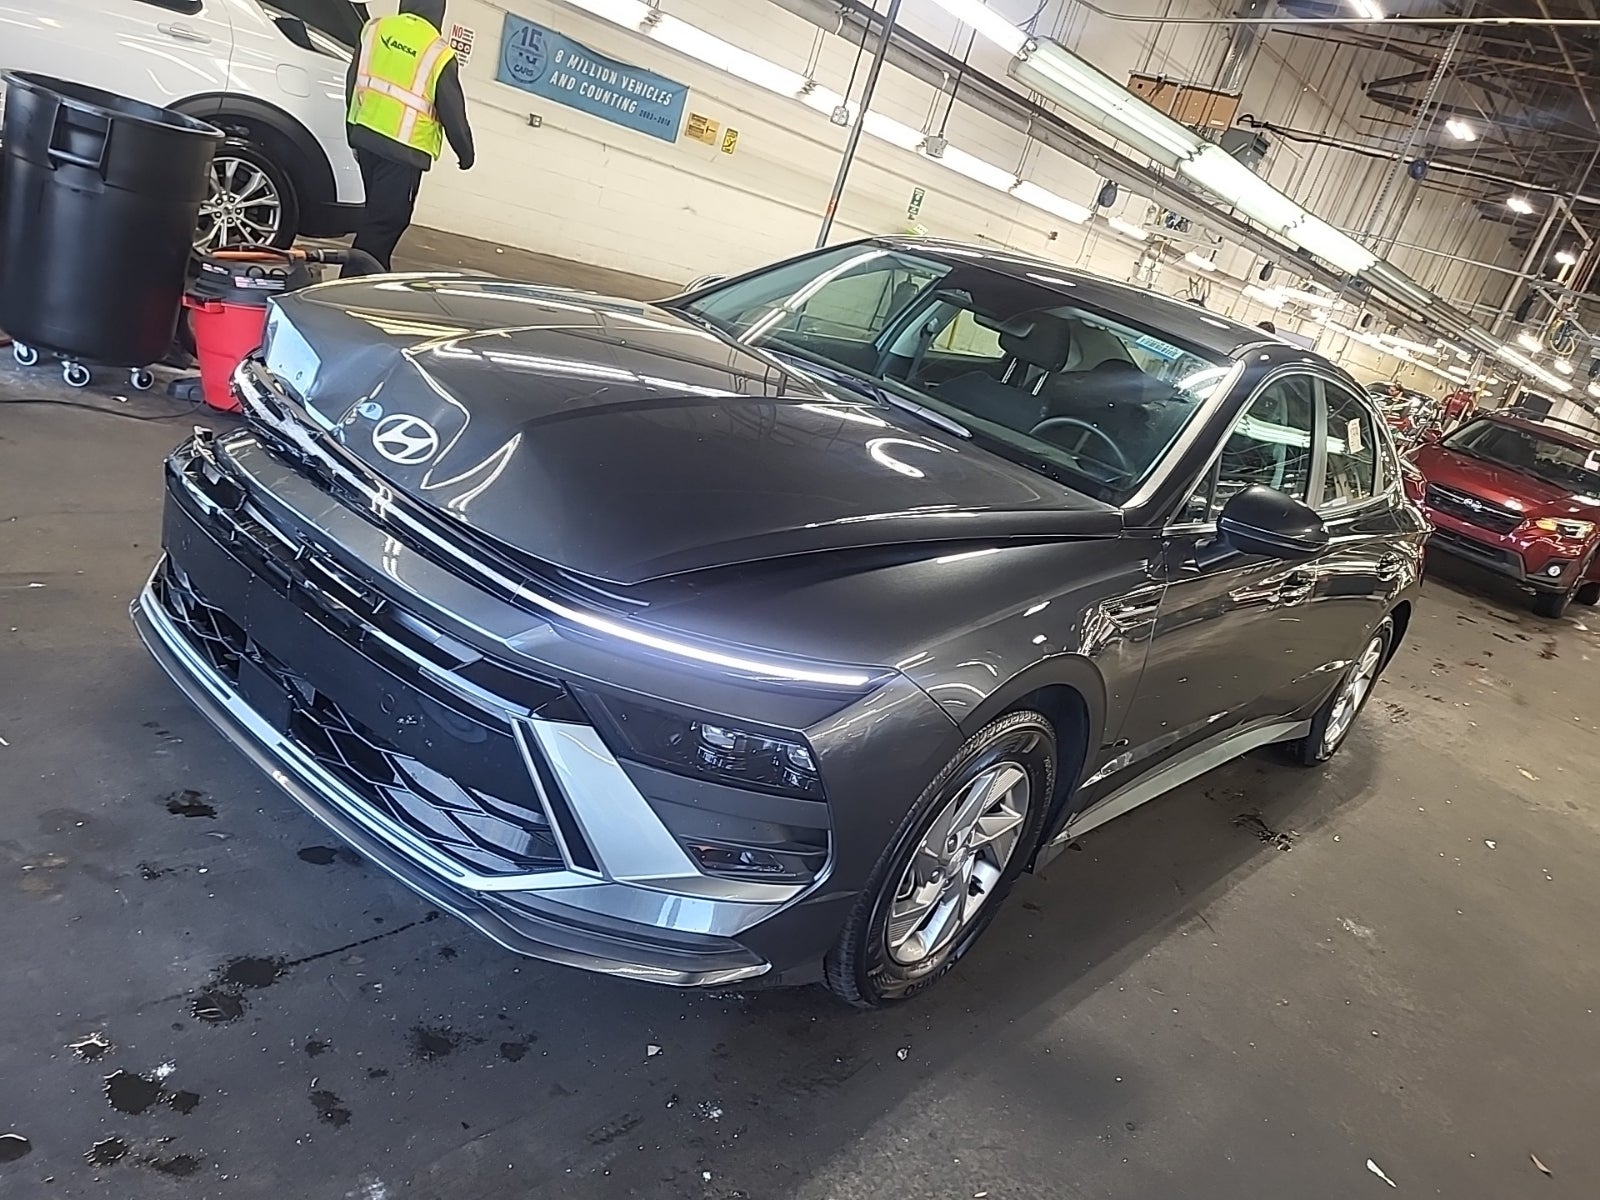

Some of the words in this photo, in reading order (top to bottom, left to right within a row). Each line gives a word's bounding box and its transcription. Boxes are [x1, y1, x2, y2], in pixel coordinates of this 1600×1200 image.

[452, 24, 463, 39] NO
[521, 26, 543, 52] 15
[390, 40, 417, 58] ADESA
[555, 49, 565, 63] 8
[566, 54, 618, 85] MILLION
[621, 75, 673, 106] VEHICLES
[549, 70, 577, 90] AND
[579, 81, 638, 113] COUNTING
